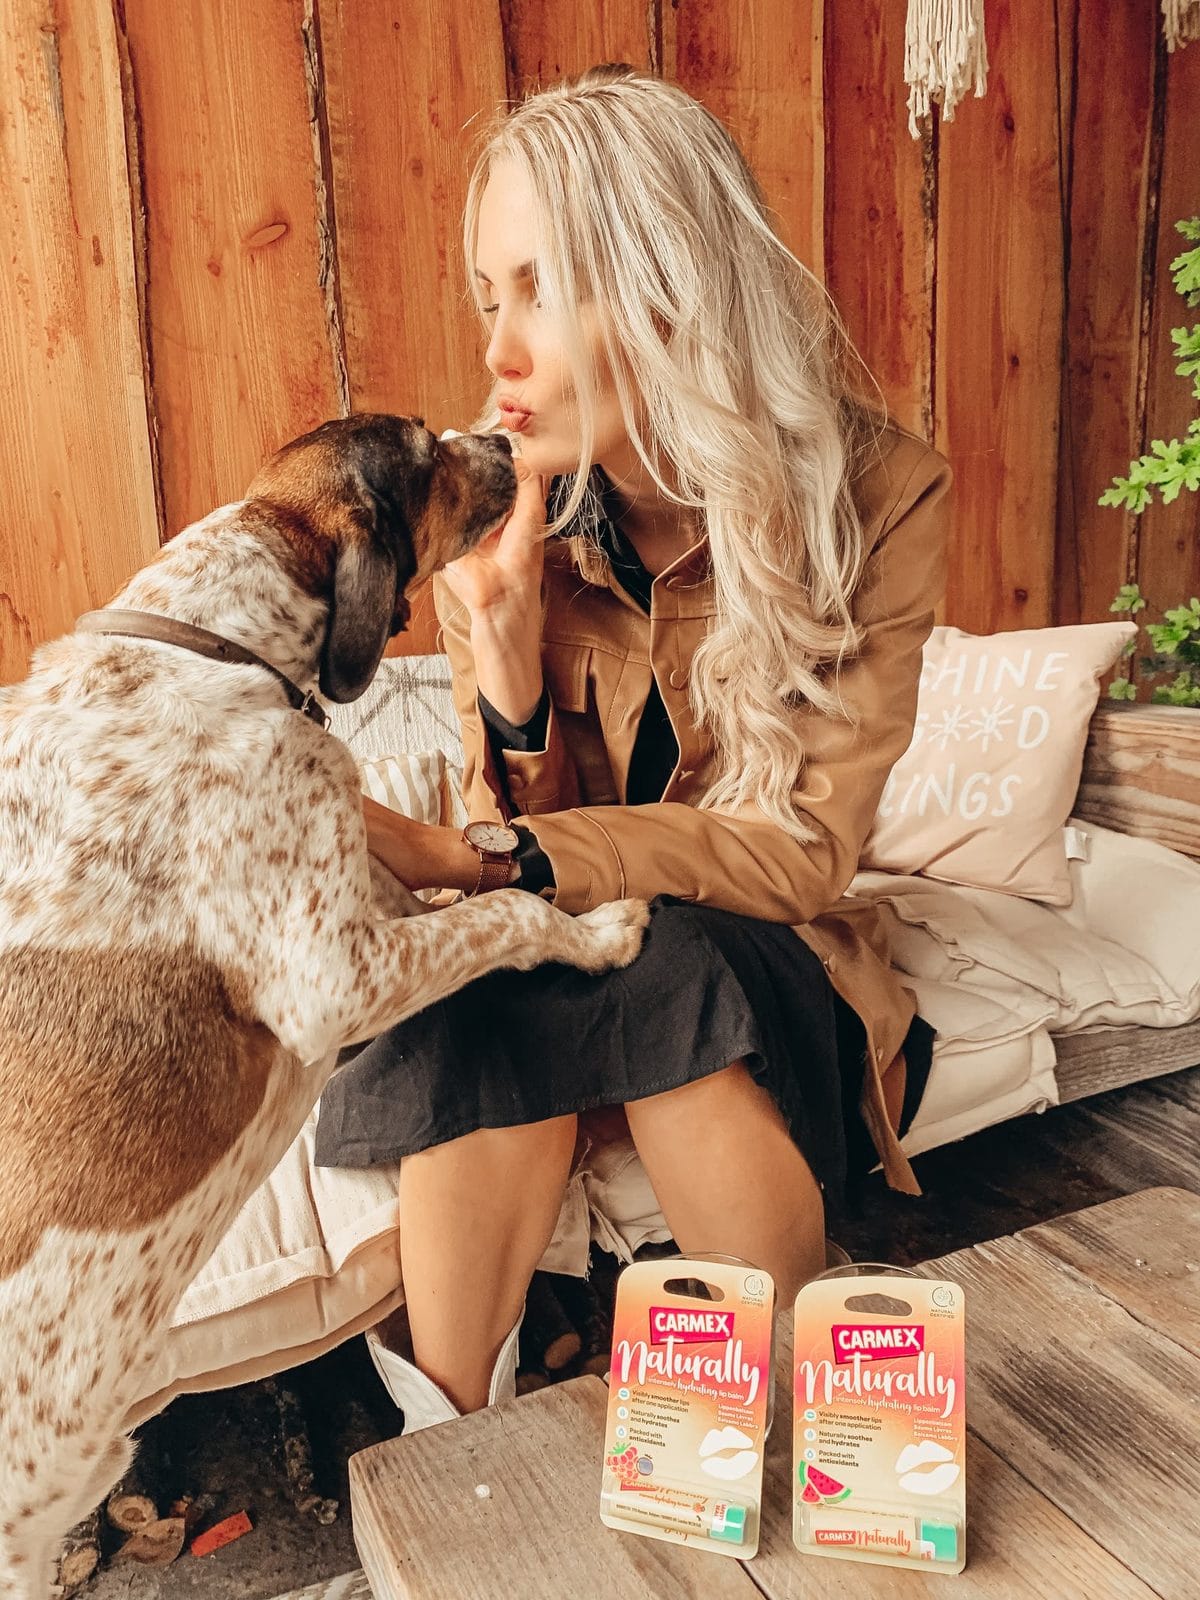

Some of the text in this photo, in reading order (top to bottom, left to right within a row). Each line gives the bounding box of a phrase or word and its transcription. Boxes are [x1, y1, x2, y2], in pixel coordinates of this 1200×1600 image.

[654, 1312, 731, 1337] CARMEX
[838, 1327, 921, 1351] CARMEX
[617, 1335, 760, 1406] Naturally
[677, 1378, 718, 1401] hydrating
[719, 1390, 727, 1398] lip
[727, 1391, 744, 1400] balm
[800, 1351, 955, 1419] Naturally
[632, 1390, 650, 1399] Visibly
[651, 1394, 679, 1403] smoother
[631, 1397, 645, 1405] after
[657, 1402, 689, 1413] application
[868, 1394, 912, 1416] hydrating
[913, 1404, 922, 1412] lip
[922, 1405, 941, 1413] balm
[631, 1409, 680, 1423] Naturally soothes
[819, 1411, 840, 1419] Visibly
[840, 1414, 871, 1422] smoother
[641, 1419, 668, 1428] hydrates
[847, 1422, 882, 1431] application
[629, 1427, 649, 1436] Packed
[819, 1430, 873, 1442] Naturally soothes
[629, 1435, 666, 1447] antioxidants
[831, 1439, 860, 1448] hydrates
[819, 1450, 841, 1458] Packed
[819, 1458, 859, 1467] antioxidants
[819, 1533, 855, 1541] CARMEX
[856, 1528, 911, 1553] Naturally
